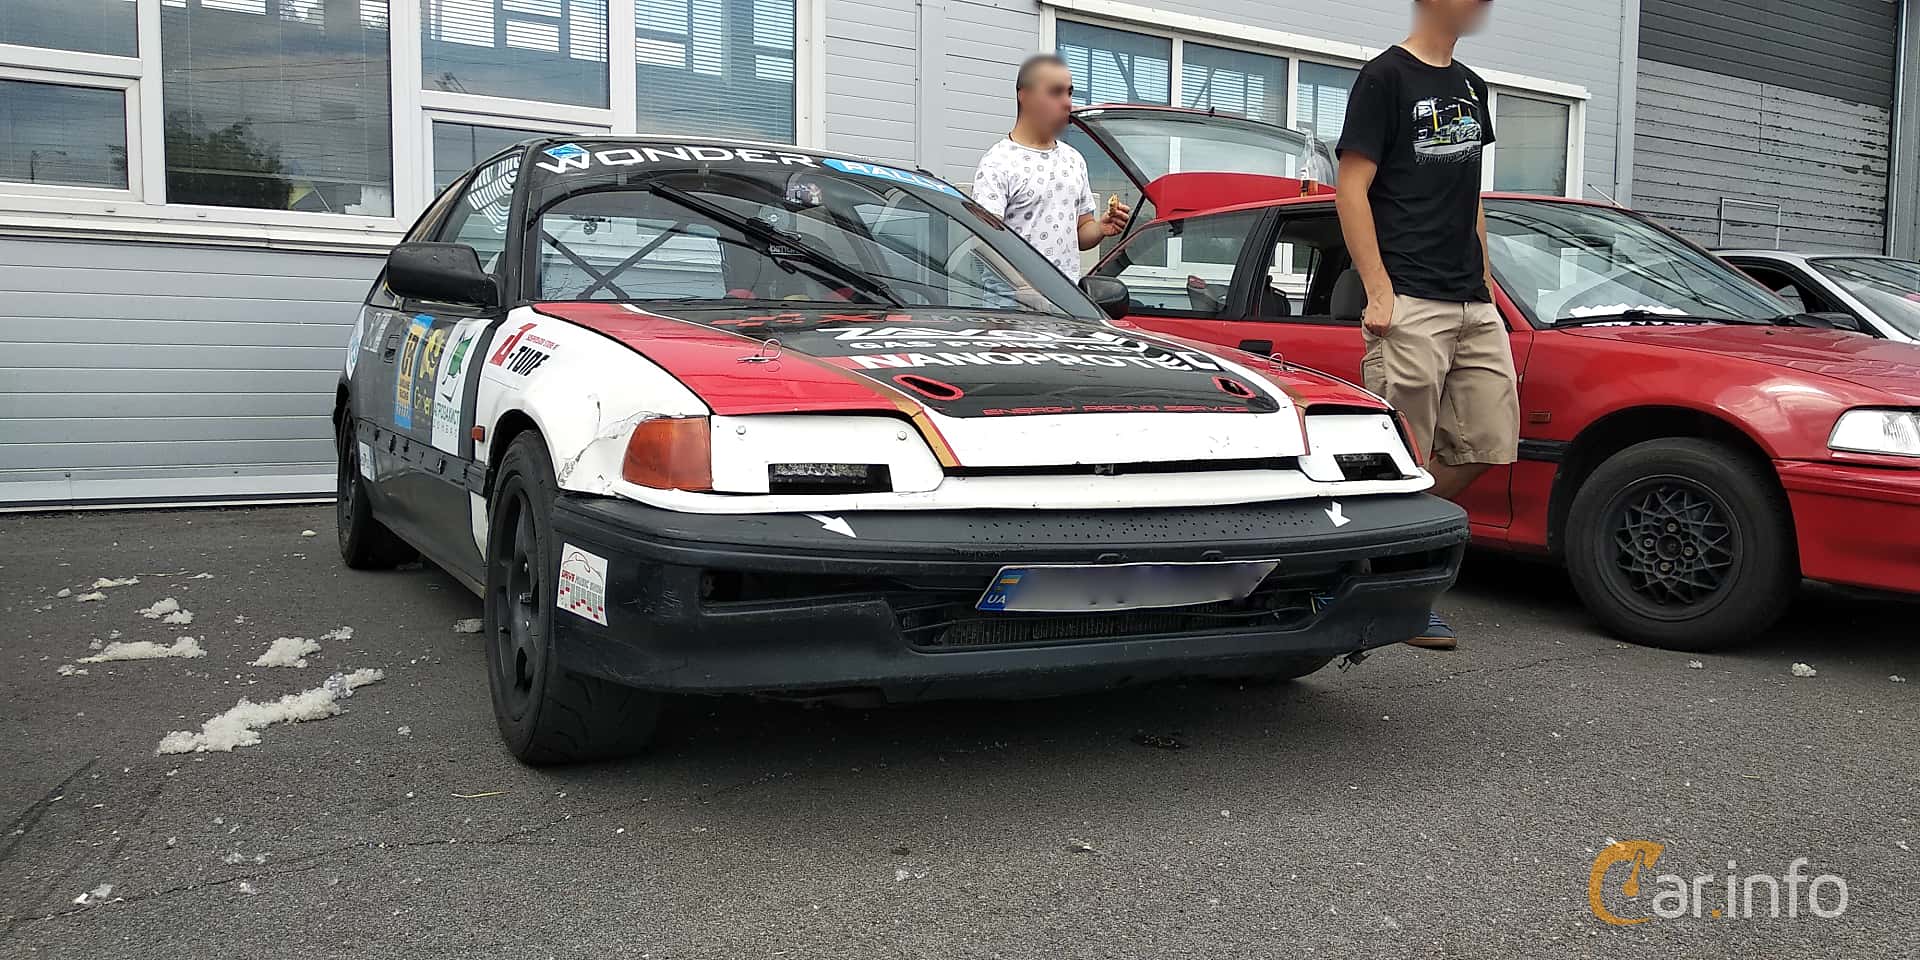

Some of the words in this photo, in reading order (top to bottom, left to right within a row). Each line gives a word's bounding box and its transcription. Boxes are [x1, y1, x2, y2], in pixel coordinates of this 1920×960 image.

[535, 146, 821, 174] WONDER
[841, 160, 945, 192] RALLY
[987, 594, 1006, 604] UA
